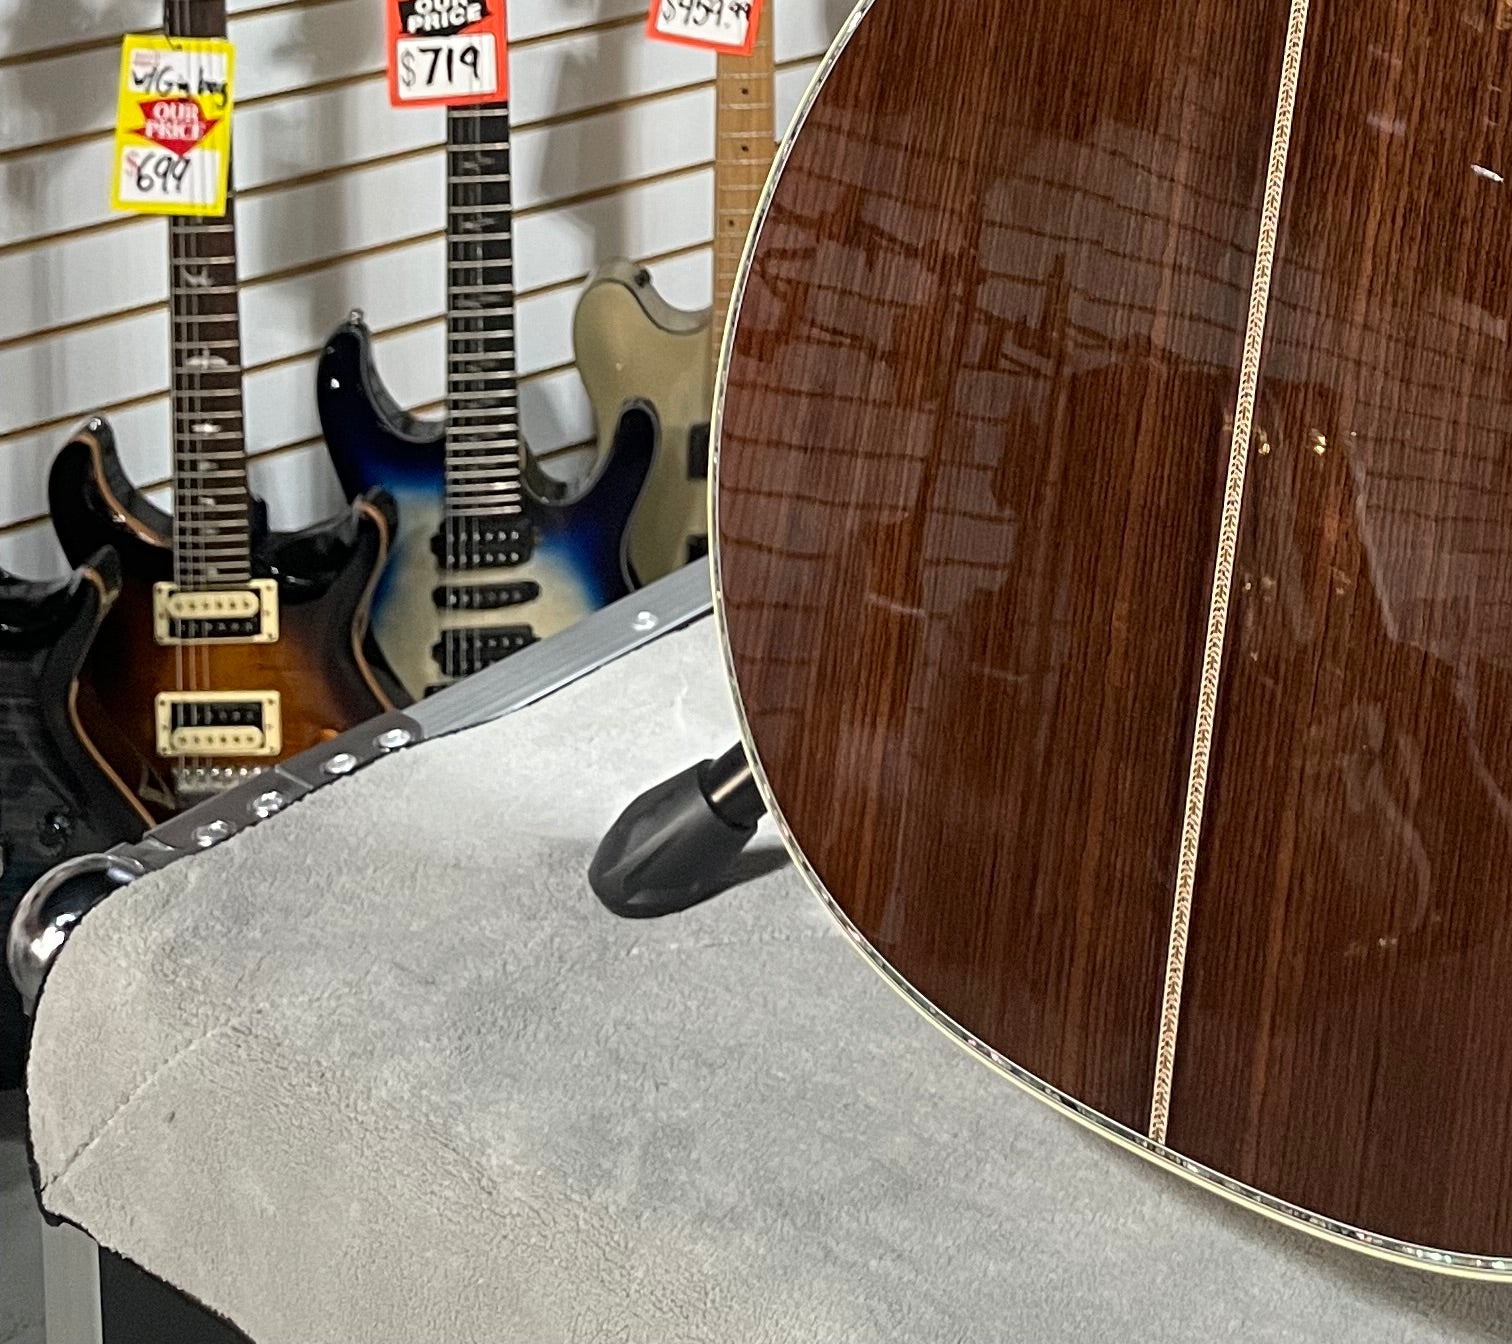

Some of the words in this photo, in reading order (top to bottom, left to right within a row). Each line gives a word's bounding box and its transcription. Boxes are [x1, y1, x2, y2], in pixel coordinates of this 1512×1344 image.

[406, 2, 483, 35] PRICE
[400, 45, 481, 89] $719
[152, 101, 200, 122] OUR
[144, 120, 207, 142] PRICE
